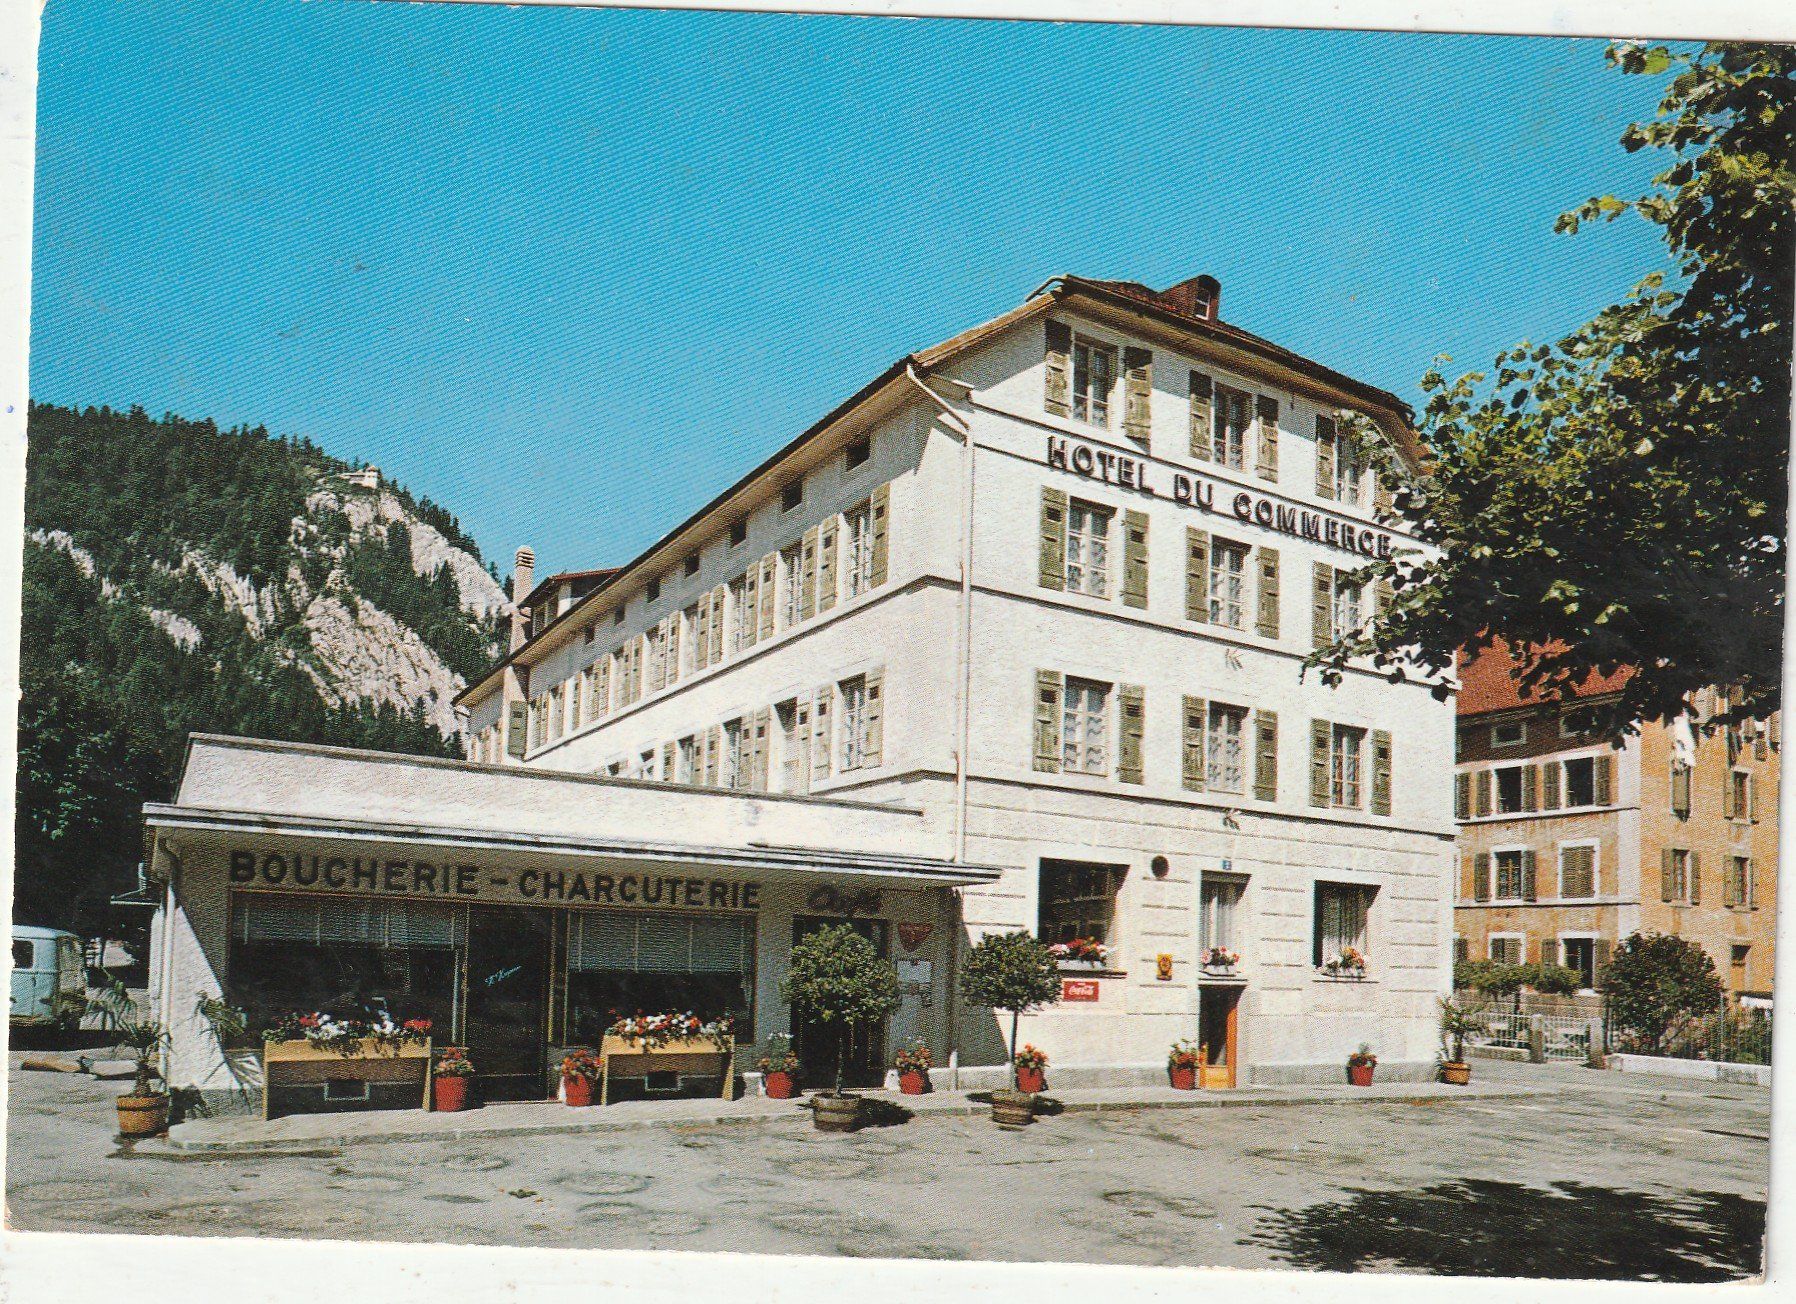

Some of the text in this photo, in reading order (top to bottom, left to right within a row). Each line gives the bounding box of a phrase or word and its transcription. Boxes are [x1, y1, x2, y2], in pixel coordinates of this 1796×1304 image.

[1046, 435, 1393, 561] HOTEL DU COMMERCE
[230, 850, 480, 895] BOUCHERIE
[518, 868, 762, 909] CHARCUTERIE
